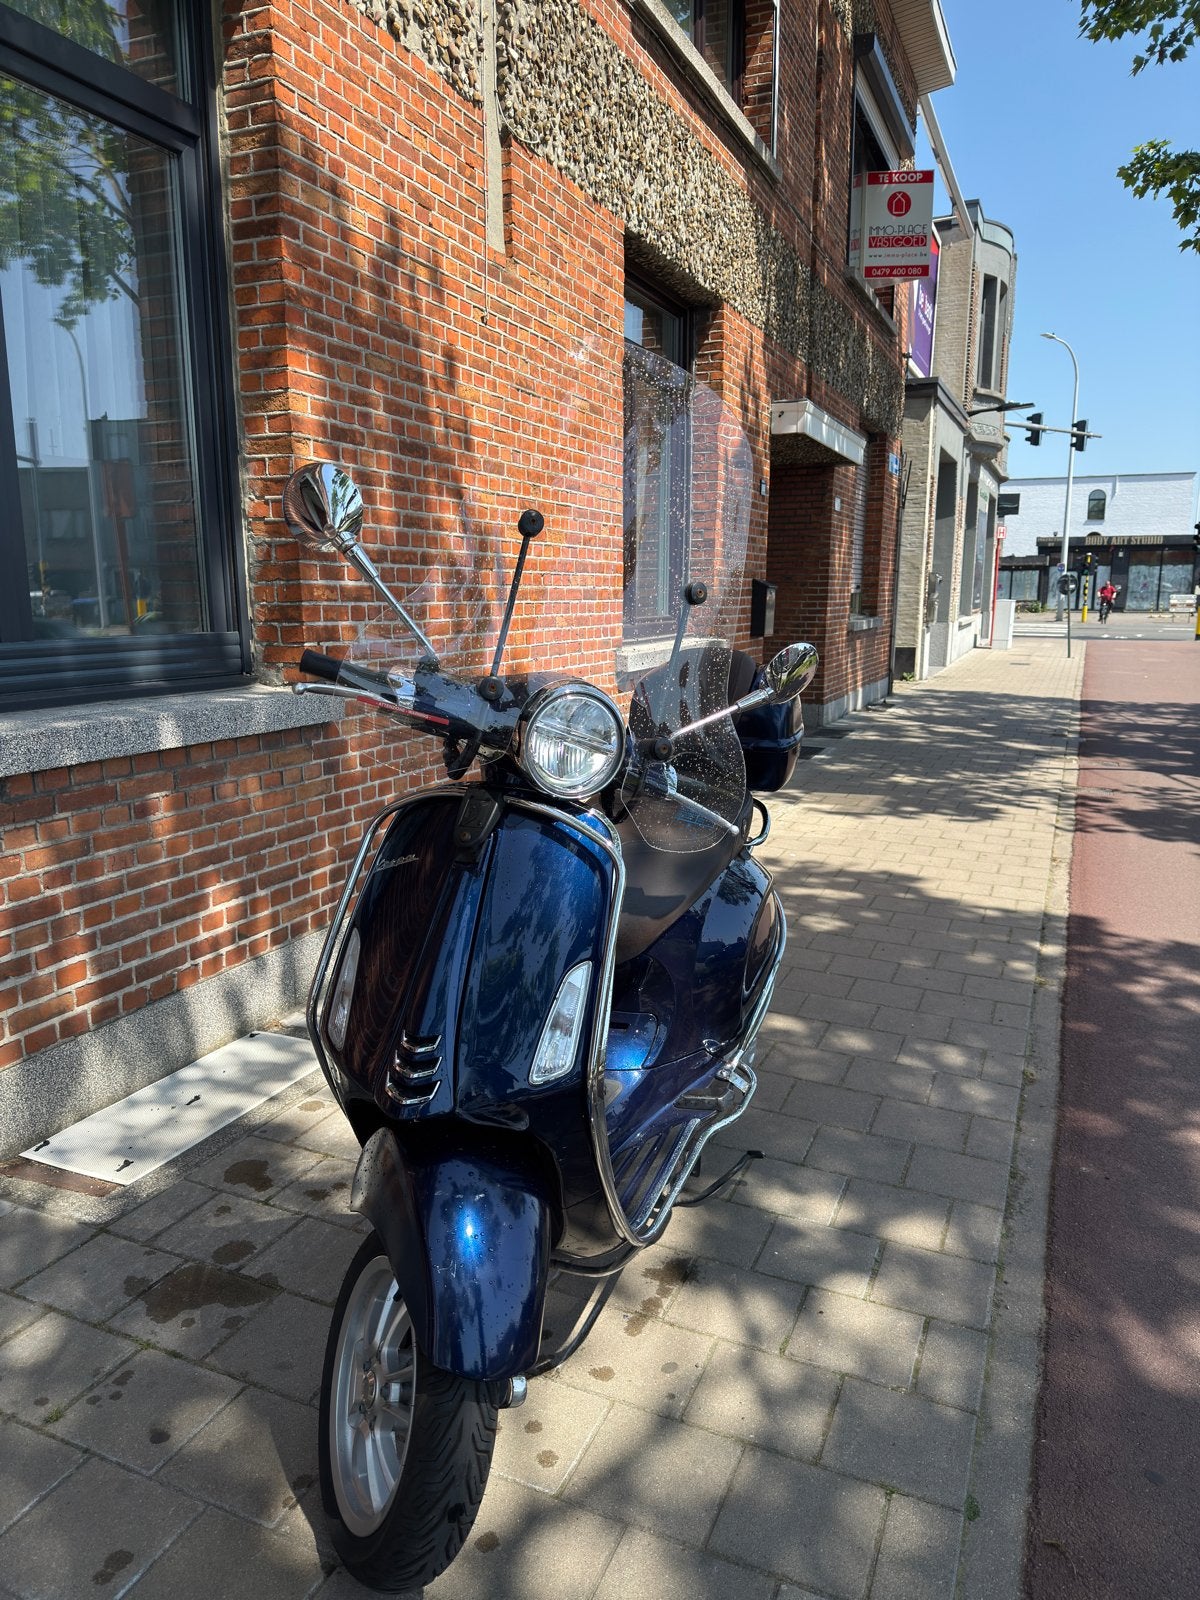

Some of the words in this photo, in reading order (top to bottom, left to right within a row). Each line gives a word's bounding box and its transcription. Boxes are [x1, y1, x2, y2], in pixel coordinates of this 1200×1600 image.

[879, 174, 889, 182] TE
[892, 173, 923, 182] KOOP
[870, 236, 926, 247] VASTGOED
[892, 267, 906, 275] 400
[1085, 536, 1109, 545] BODY
[1111, 536, 1129, 545] ART
[1131, 535, 1163, 545] STUDIO
